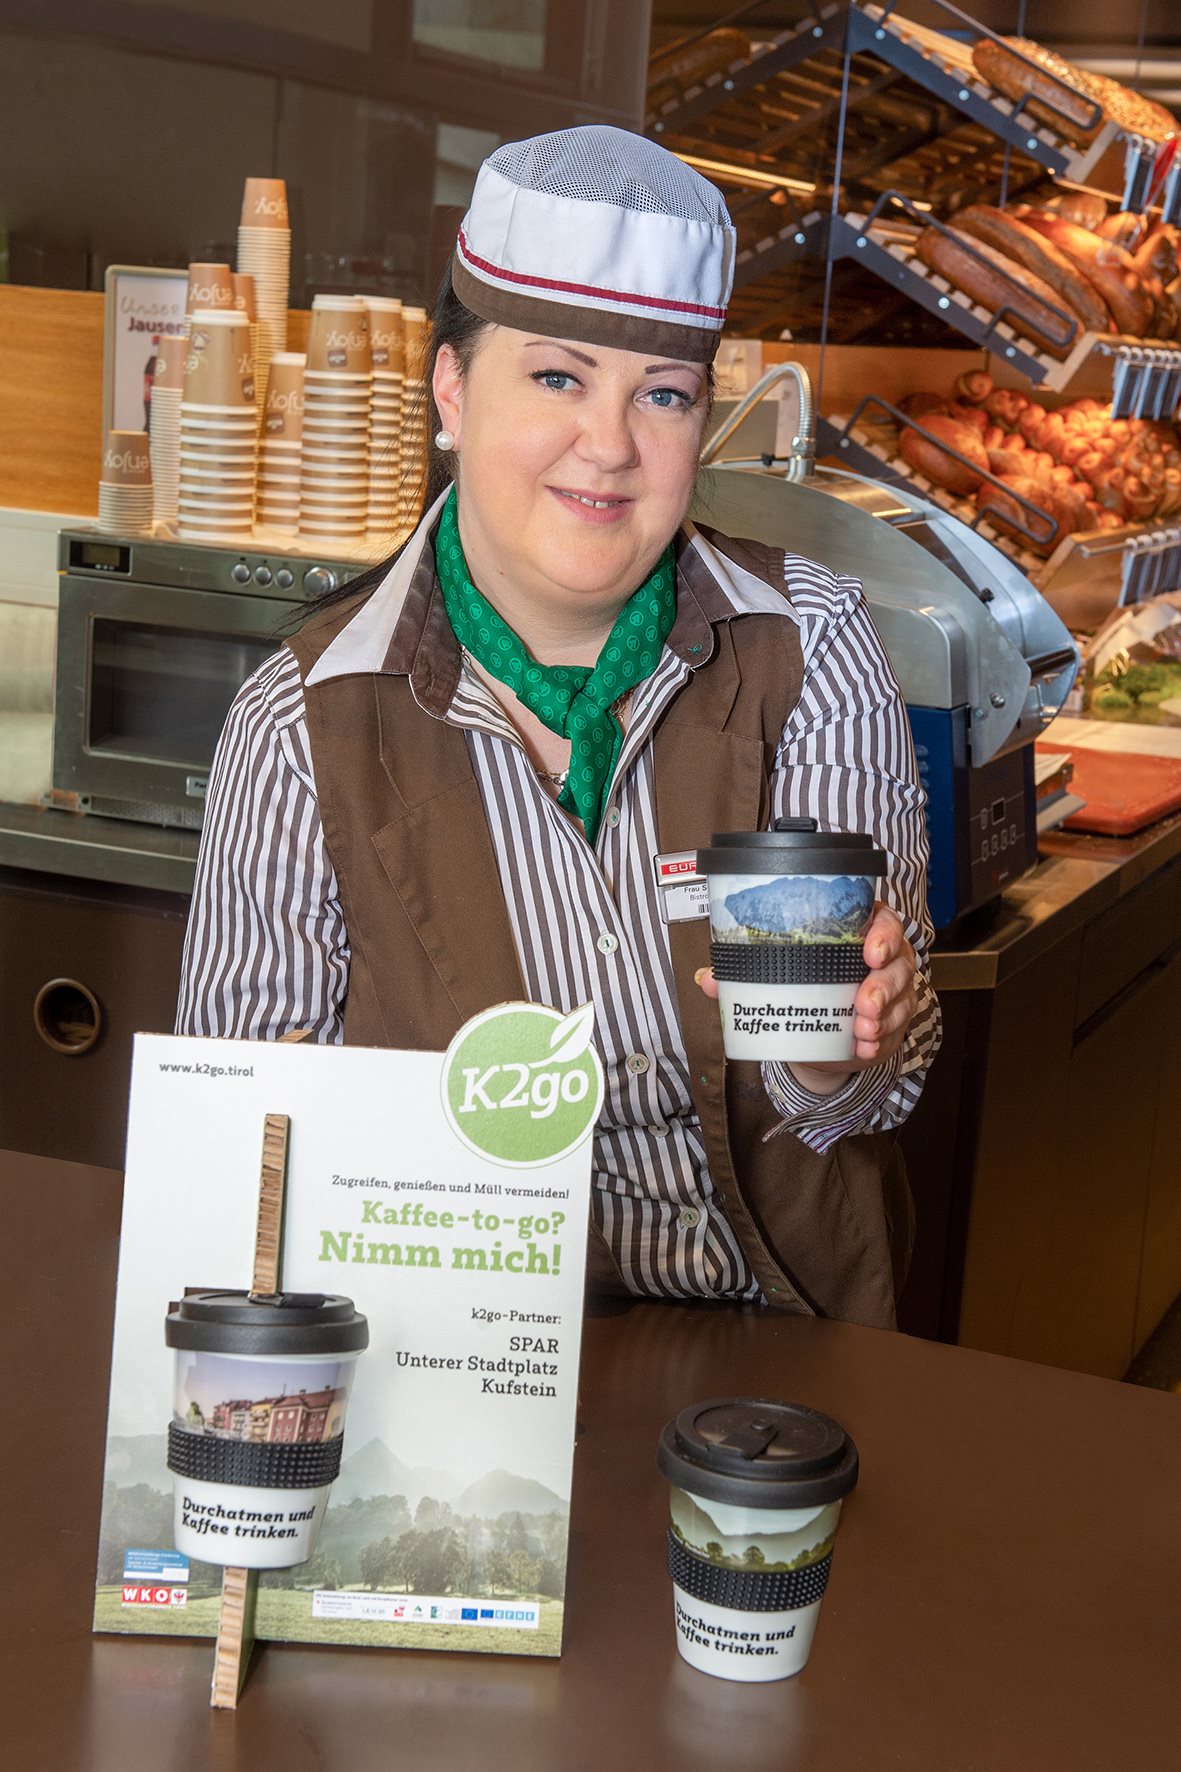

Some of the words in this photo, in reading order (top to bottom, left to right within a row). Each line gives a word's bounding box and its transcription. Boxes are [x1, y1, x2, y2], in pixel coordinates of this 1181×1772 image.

[684, 885, 700, 893] Frau
[733, 1003, 828, 1017] Durchatmen
[832, 1004, 855, 1017] und
[733, 1018, 780, 1035] Kaffee
[785, 1020, 843, 1032] trinken.
[159, 1063, 254, 1078] www.k2go.tirol
[459, 1062, 589, 1119] K2go
[332, 1175, 392, 1189] Zugreifen,
[393, 1180, 446, 1192] genießen
[449, 1183, 471, 1194] und
[474, 1184, 502, 1195] Müll
[505, 1187, 570, 1200] vermeiden!
[361, 1200, 566, 1239] Kaffee-to-go?
[318, 1230, 442, 1268] Nimm
[451, 1241, 562, 1276] mich!
[471, 1308, 562, 1324] k2go-Partner:
[510, 1336, 559, 1354] SPAR
[396, 1352, 463, 1370] Unterer
[467, 1356, 558, 1376] Stadtplatz
[481, 1378, 557, 1397] Kufstein
[182, 1496, 284, 1522] Durchatmen
[288, 1505, 317, 1523] und
[182, 1512, 229, 1535] Kaffee
[235, 1525, 299, 1539] trinken.
[123, 1588, 169, 1603] WKO
[676, 1601, 760, 1642] Durchatmen
[765, 1625, 797, 1641] und
[676, 1616, 710, 1647] Kaffee
[714, 1642, 779, 1656] trinken.
